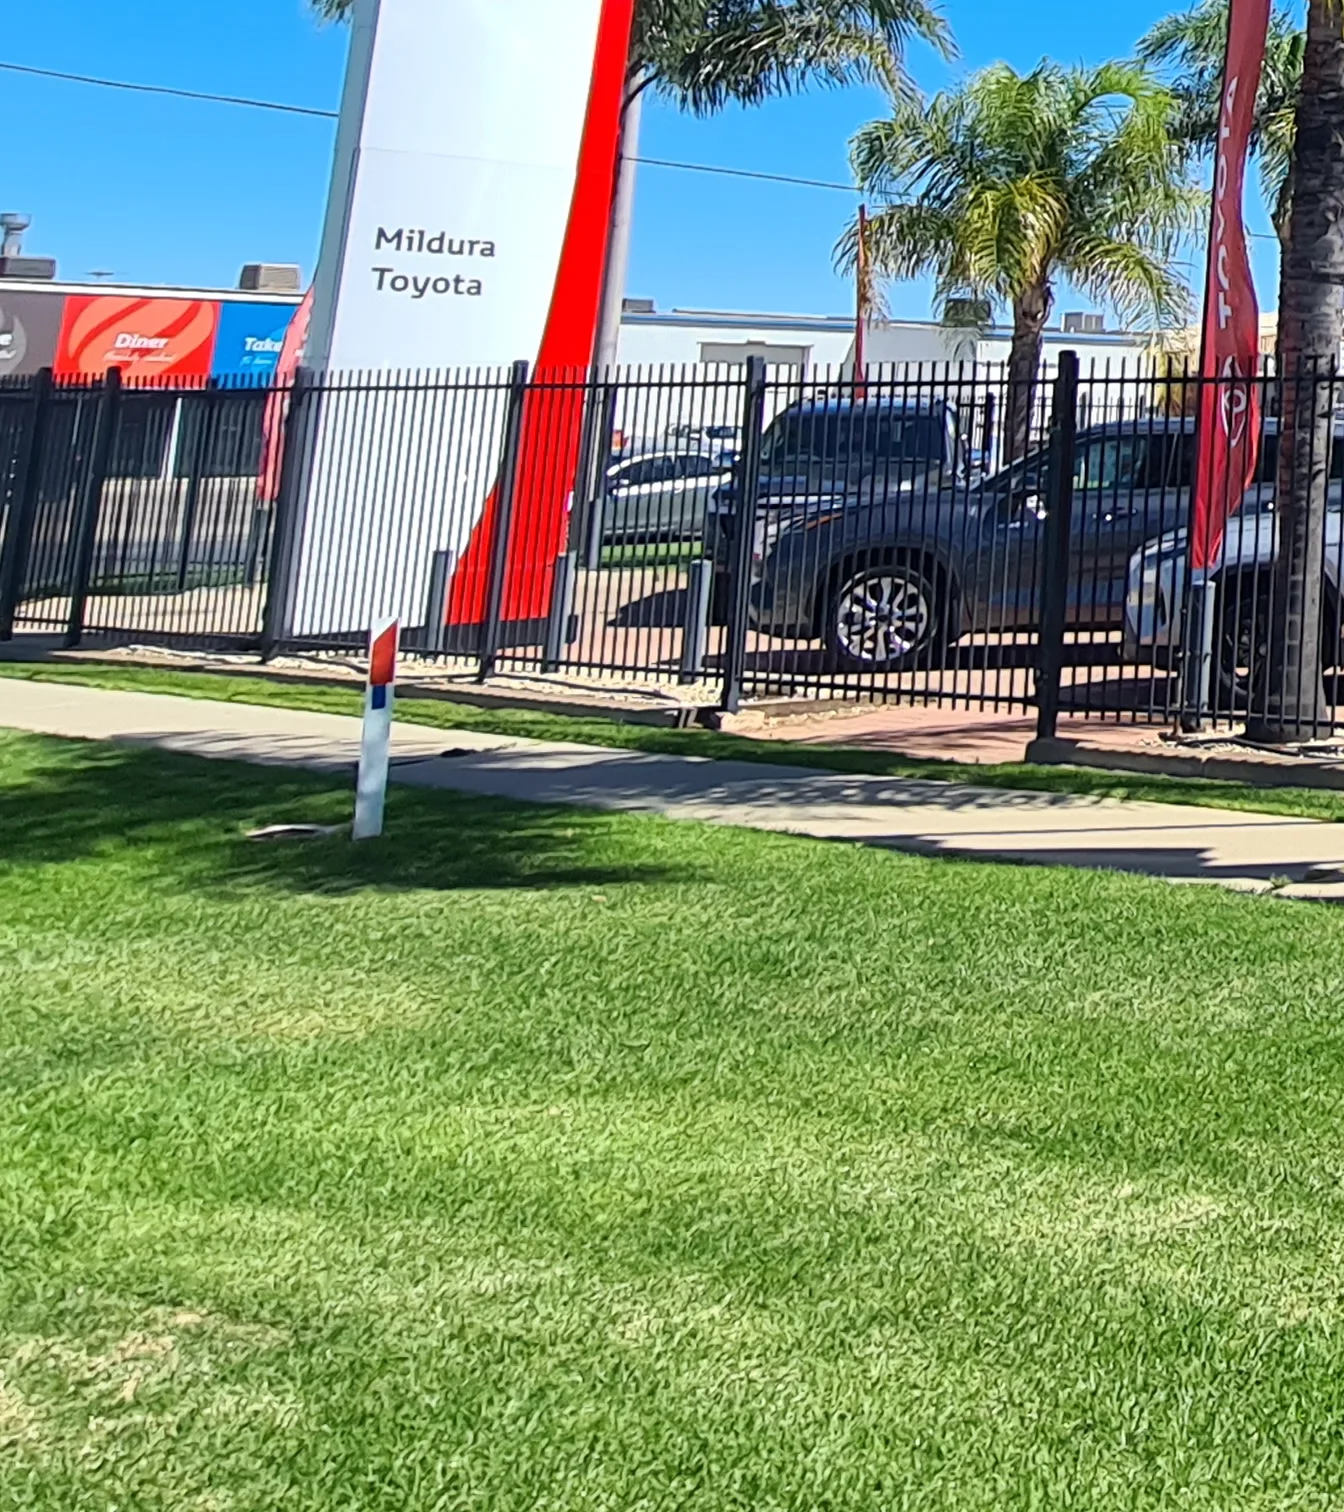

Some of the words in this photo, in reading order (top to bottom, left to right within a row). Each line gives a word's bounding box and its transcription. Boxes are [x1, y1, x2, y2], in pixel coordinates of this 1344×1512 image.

[374, 226, 496, 257] Mildura
[371, 267, 483, 299] Toyota
[114, 332, 169, 349] Diner
